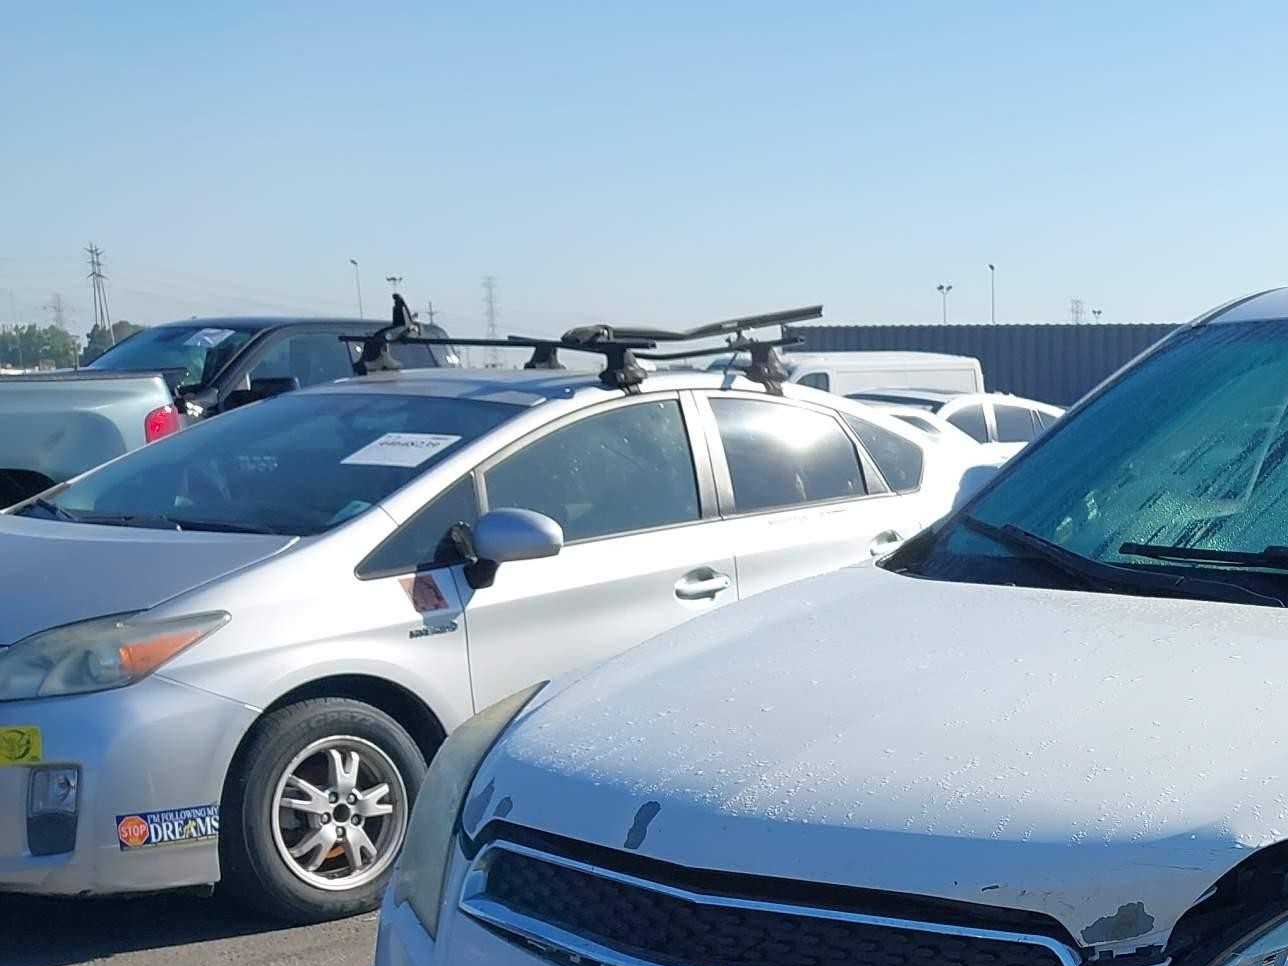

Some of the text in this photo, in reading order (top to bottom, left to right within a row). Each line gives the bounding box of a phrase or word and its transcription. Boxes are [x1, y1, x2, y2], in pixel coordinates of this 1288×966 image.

[147, 805, 219, 824] I'M FOLLOWING MY
[121, 825, 147, 838] STOP
[149, 815, 219, 843] DREAMS
